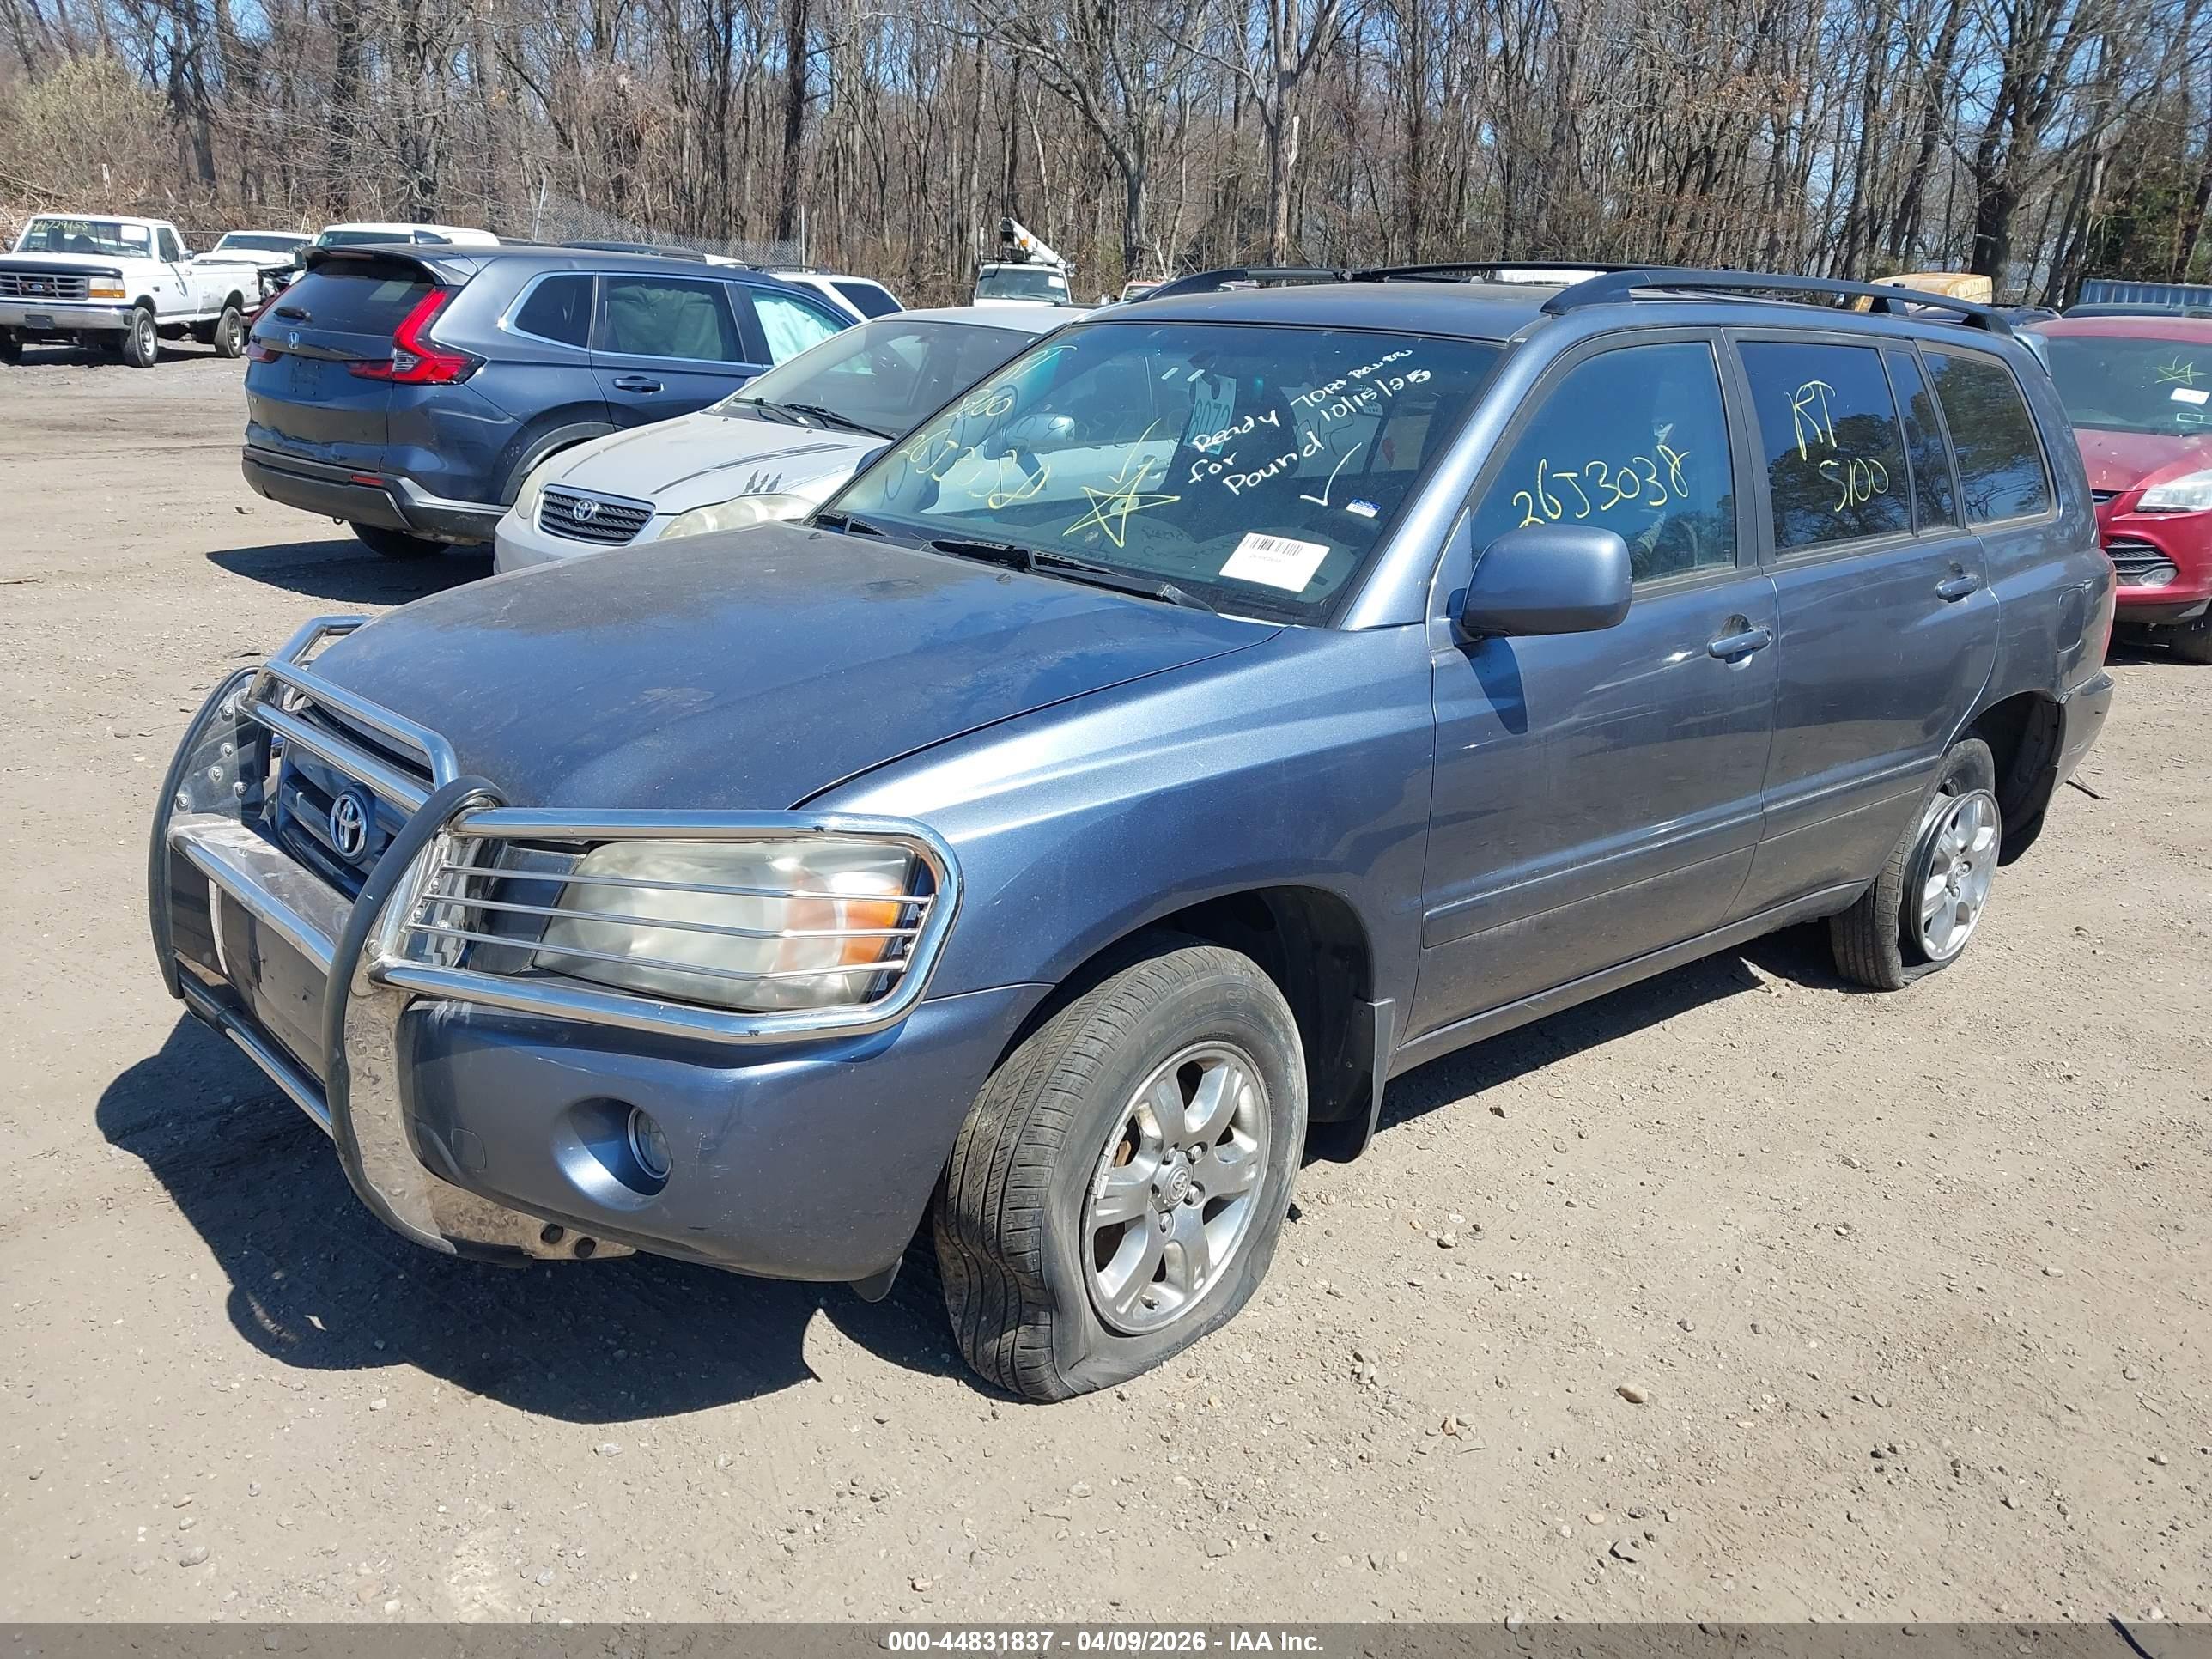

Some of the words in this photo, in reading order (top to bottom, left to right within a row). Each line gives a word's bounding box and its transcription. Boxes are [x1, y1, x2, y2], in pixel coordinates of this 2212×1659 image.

[1192, 410, 1281, 453] Ready
[1784, 380, 1838, 462] RT
[1188, 451, 1237, 484] for
[1223, 430, 1326, 495] Pound
[1511, 444, 1691, 529] 26J3038
[1818, 458, 1890, 513] S100
